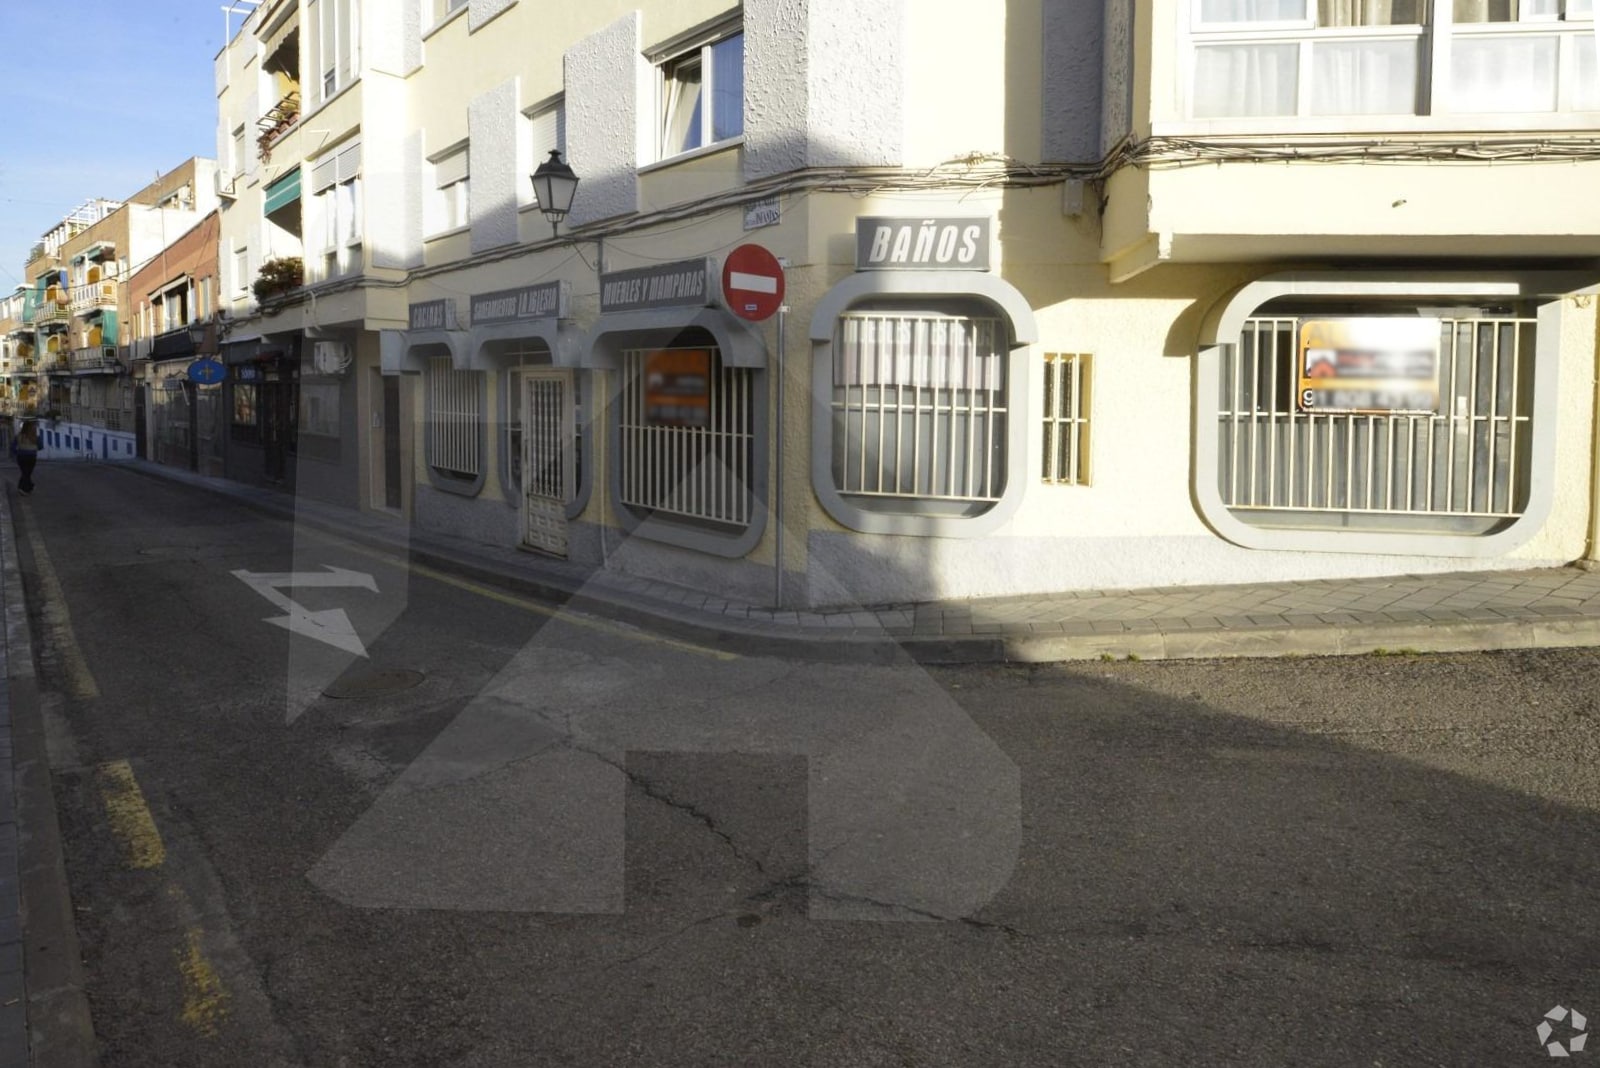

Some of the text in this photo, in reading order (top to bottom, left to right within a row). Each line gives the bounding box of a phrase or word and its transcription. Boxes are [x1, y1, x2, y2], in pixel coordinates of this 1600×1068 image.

[869, 219, 981, 263] BAÑOS
[473, 287, 557, 321] SANEAMIENTOS LA IGLESIA
[603, 269, 705, 306] MUEBLES Y MAMPARAS
